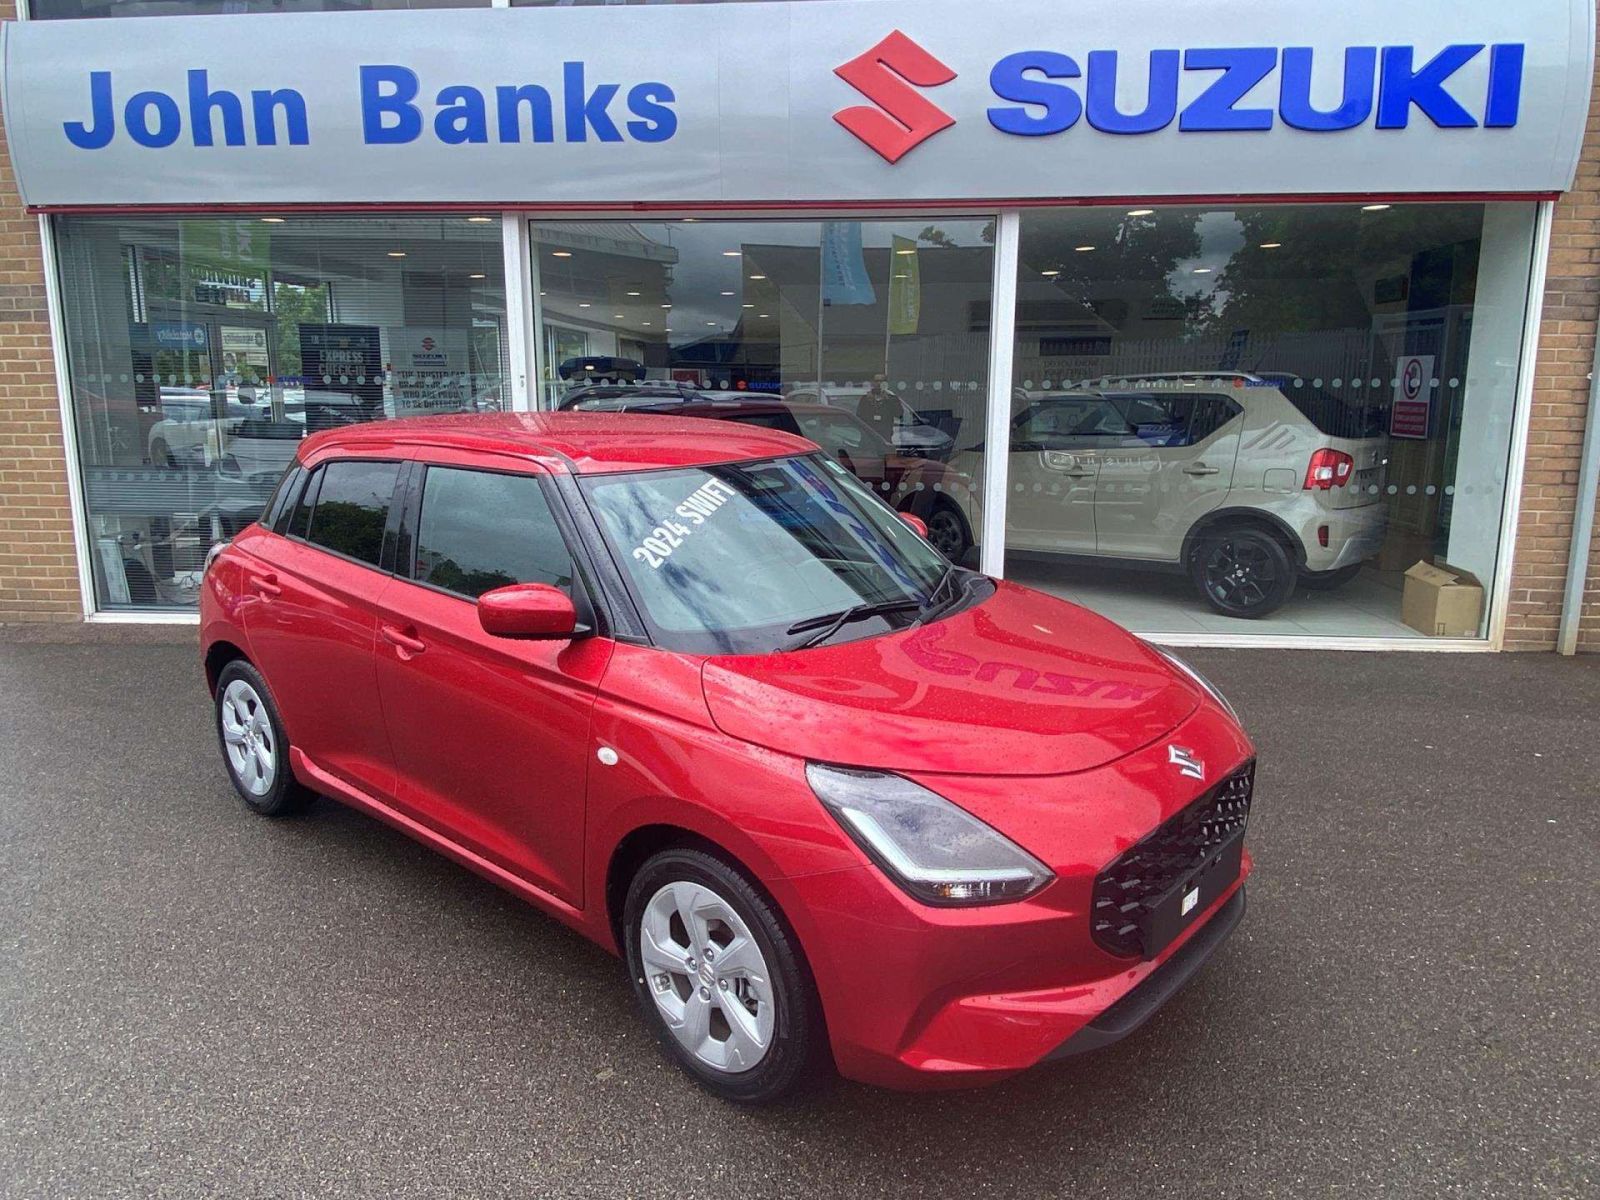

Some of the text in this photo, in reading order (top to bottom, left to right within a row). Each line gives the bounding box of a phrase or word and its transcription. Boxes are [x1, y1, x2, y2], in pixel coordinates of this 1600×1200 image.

[63, 61, 678, 150] John Banks
[987, 43, 1525, 137] SUZUKI
[319, 349, 364, 363] EXPRESS
[633, 477, 736, 569] 2024 SWIFT
